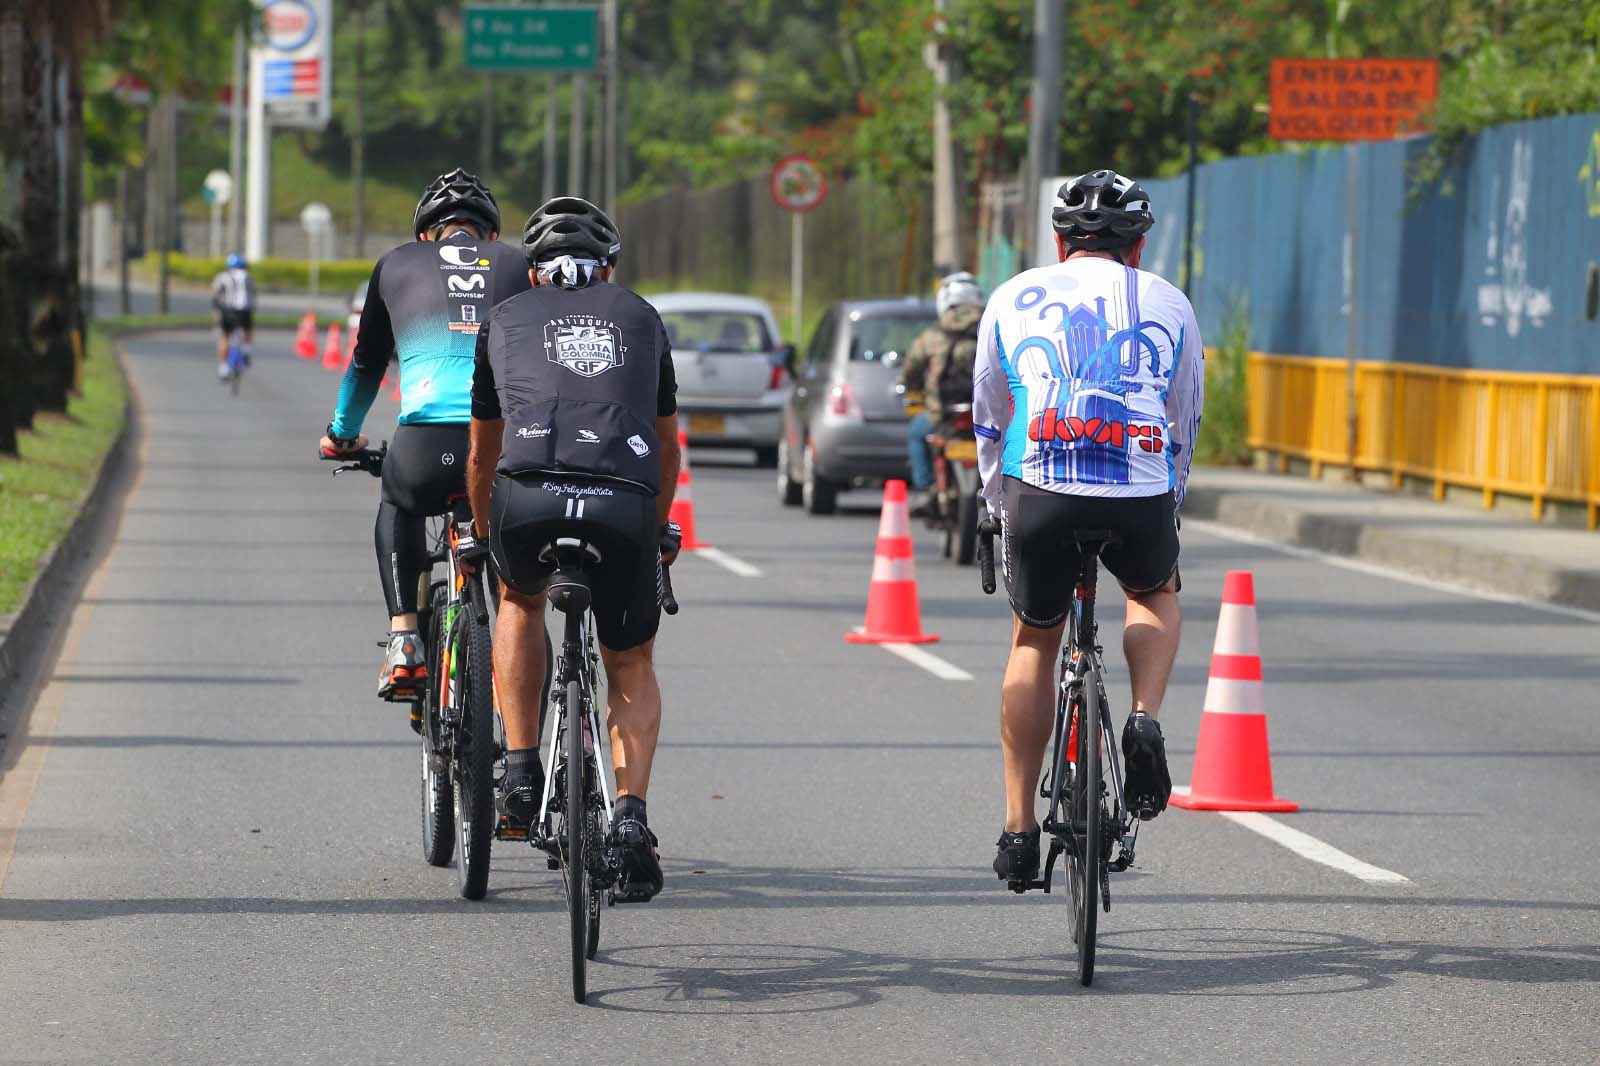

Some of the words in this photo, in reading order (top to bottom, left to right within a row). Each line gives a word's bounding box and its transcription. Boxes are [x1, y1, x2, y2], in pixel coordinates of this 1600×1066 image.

[1284, 64, 1403, 82] ENTRADA
[1411, 64, 1425, 81] Y
[1288, 90, 1378, 109] SALIDA
[1386, 91, 1417, 109] DE
[550, 318, 614, 329] ANTIOQUIA
[560, 343, 576, 351] LA
[578, 343, 611, 353] RUTA
[561, 351, 613, 360] COLOMBIA
[574, 360, 602, 373] GF
